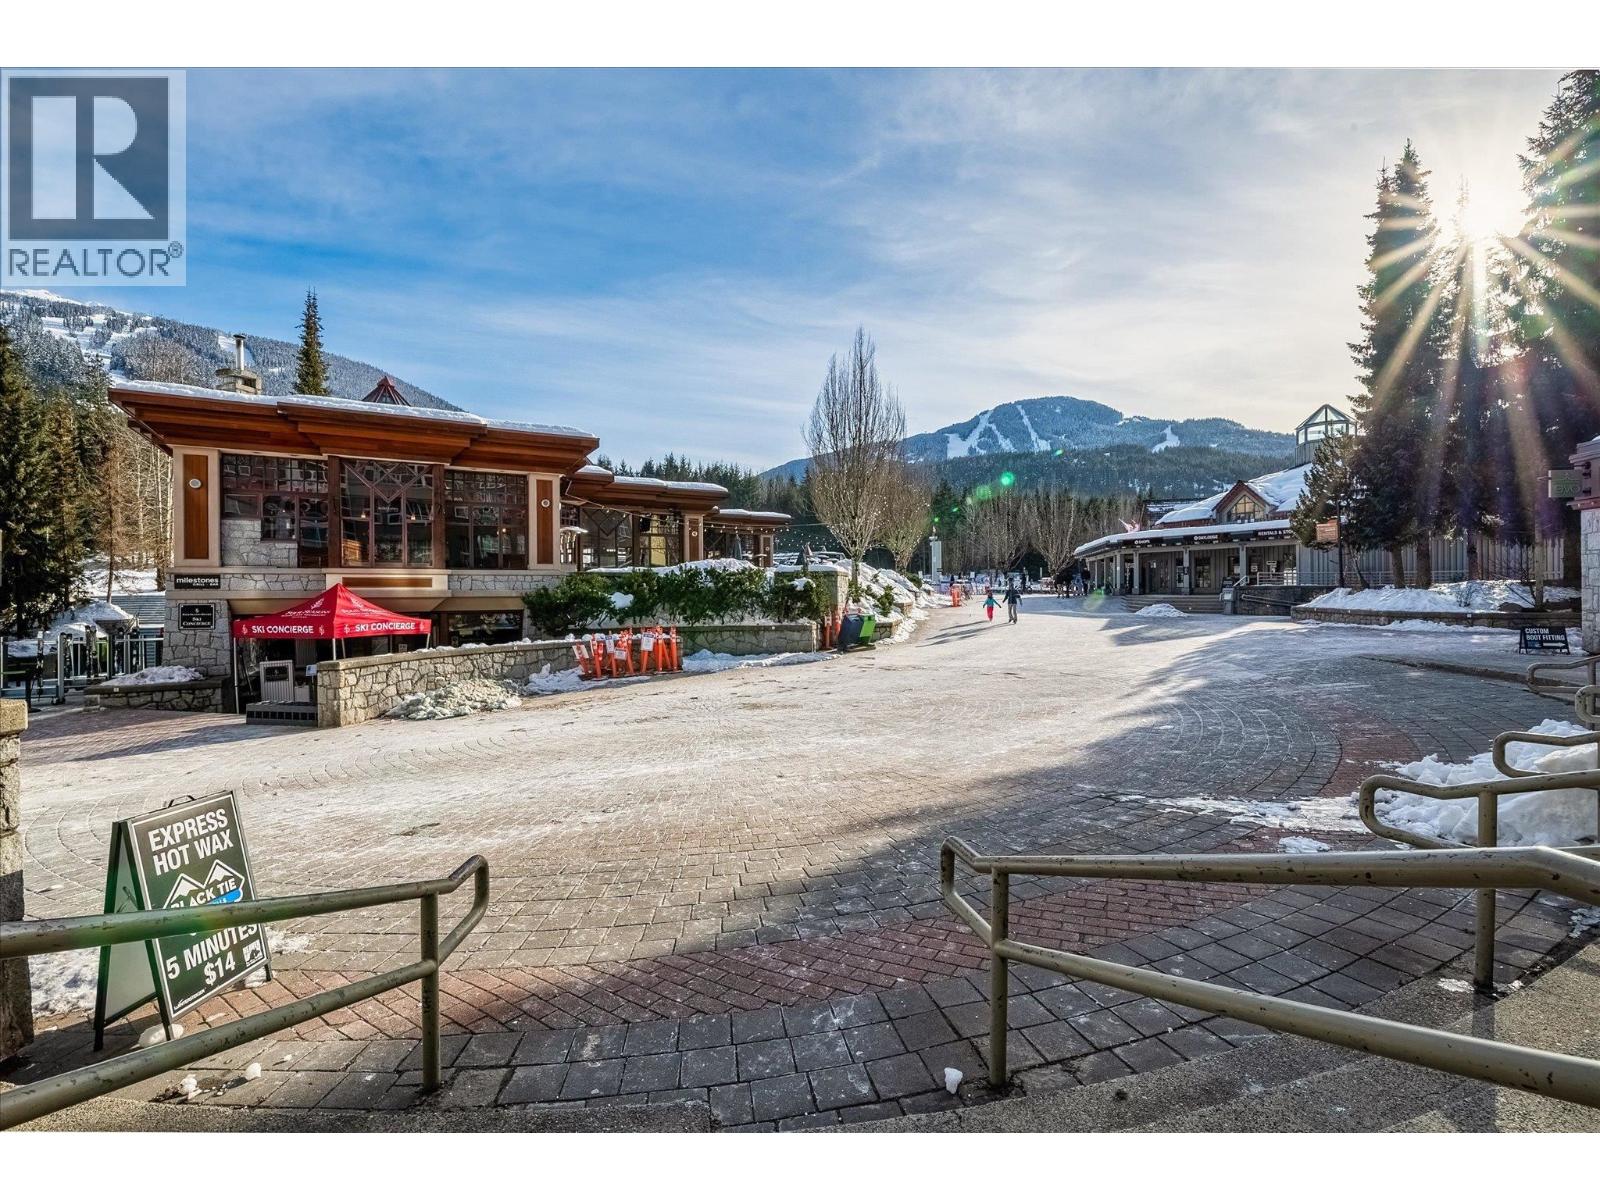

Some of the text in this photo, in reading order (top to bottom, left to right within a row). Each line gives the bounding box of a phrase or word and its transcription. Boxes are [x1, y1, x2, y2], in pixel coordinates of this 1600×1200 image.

[252, 625, 314, 634] SKI CONCIERGE
[355, 622, 415, 632] SKI CONCIERGE
[148, 809, 228, 852] EXPRESS
[153, 829, 234, 876] HOT WAX
[217, 878, 237, 895] TIE
[166, 956, 180, 980] 5
[183, 923, 258, 971] MINUTES
[203, 951, 236, 986] $14
